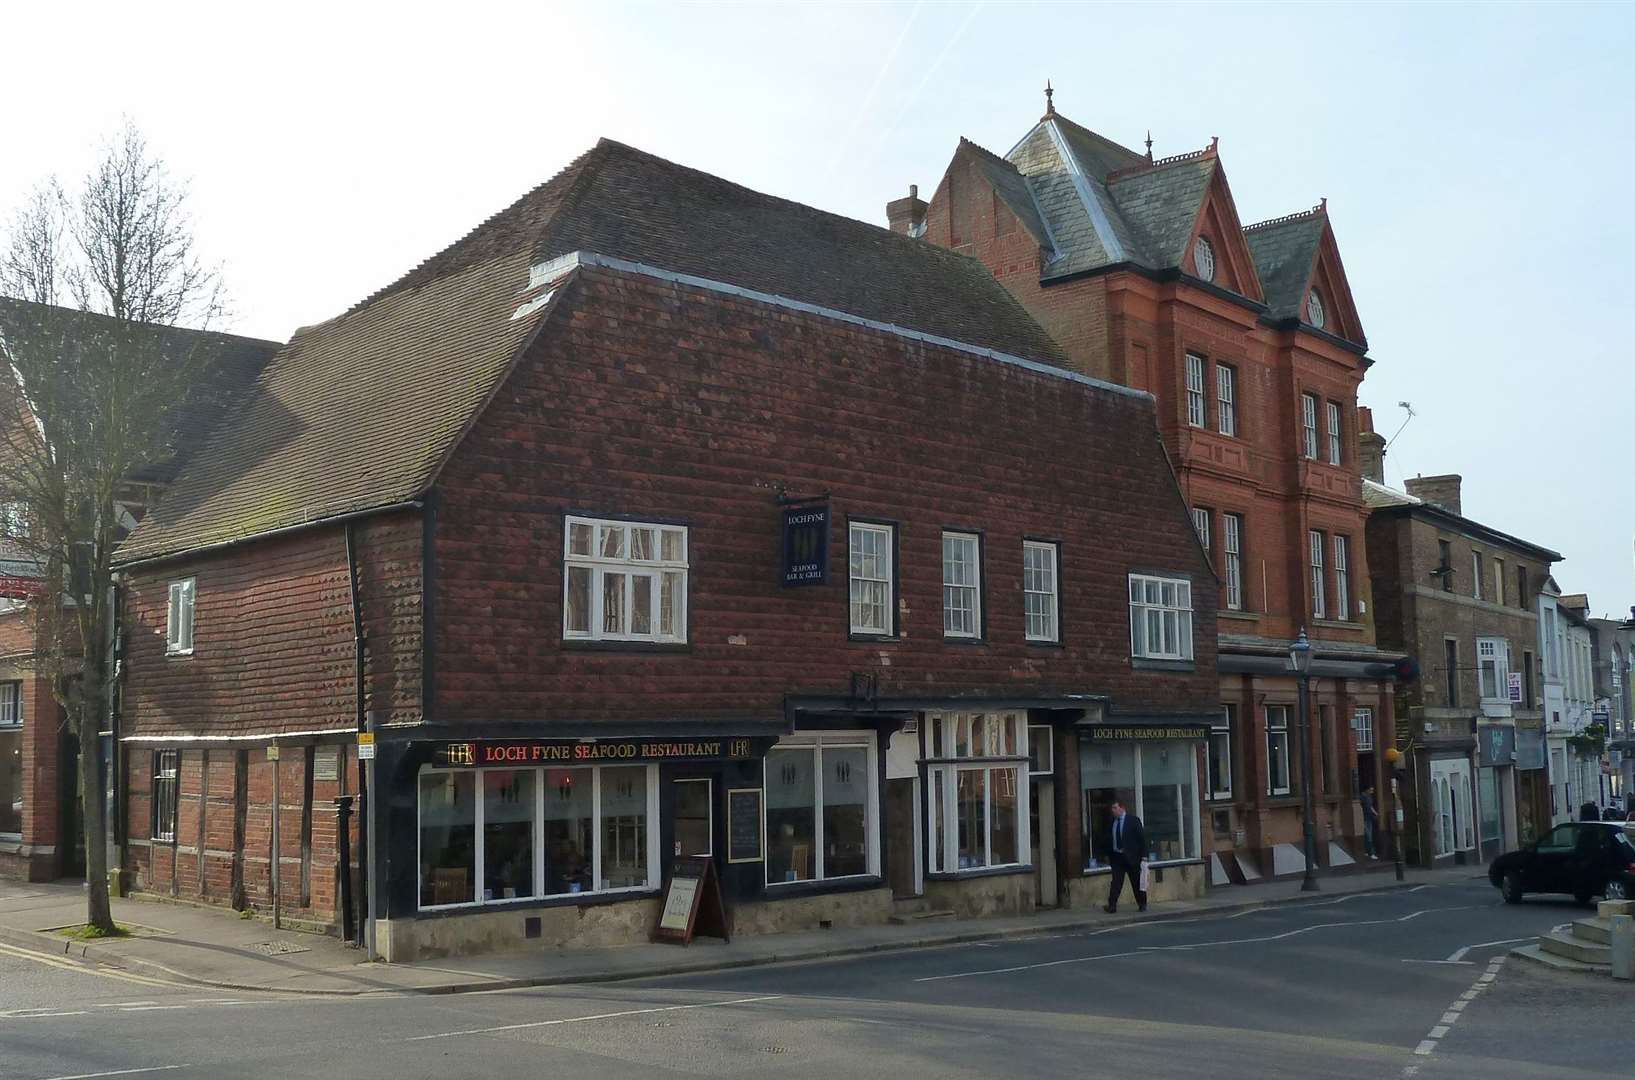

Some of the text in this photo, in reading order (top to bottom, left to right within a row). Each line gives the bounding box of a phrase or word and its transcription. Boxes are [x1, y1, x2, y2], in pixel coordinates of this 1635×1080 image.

[788, 513, 824, 525] LOCH FYNE
[1093, 729, 1205, 738] LOCH FYNE SEAFOOD RESTAURANT
[450, 744, 474, 762] LFR
[486, 742, 720, 760] LOCH FYNE SEAFOOD RESTAURANT
[730, 740, 749, 756] LFR
